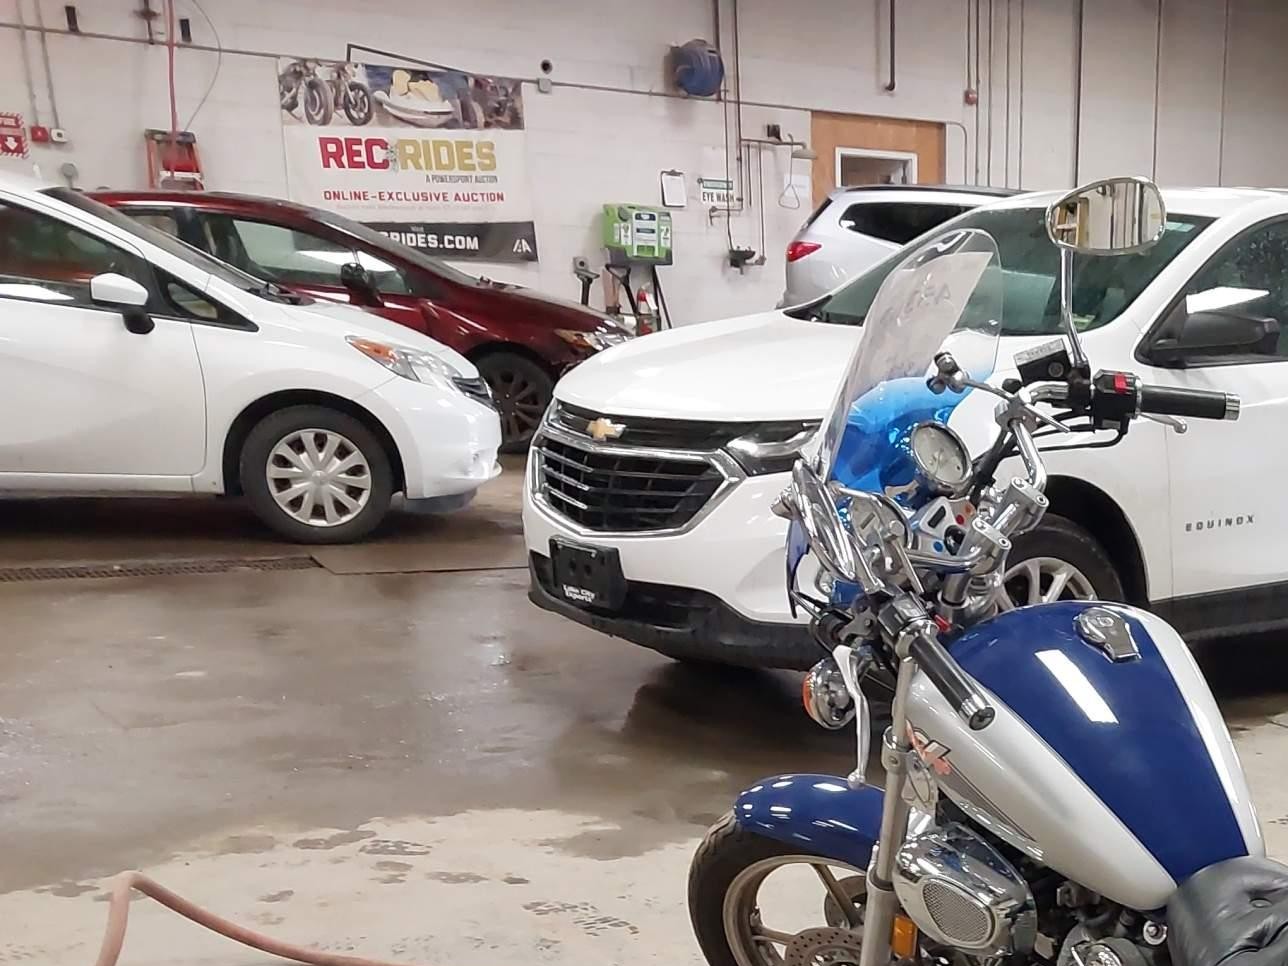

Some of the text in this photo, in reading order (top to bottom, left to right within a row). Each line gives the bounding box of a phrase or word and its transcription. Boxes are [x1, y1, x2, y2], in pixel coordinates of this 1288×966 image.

[318, 136, 498, 172] REC RIDES
[475, 175, 498, 184] AUCTION
[323, 190, 505, 202] ONLINE-EXCLUSIVE AUCTION
[702, 191, 715, 202] EYE
[379, 231, 480, 250] RIDES.COM
[1185, 514, 1255, 532] EQUINOX
